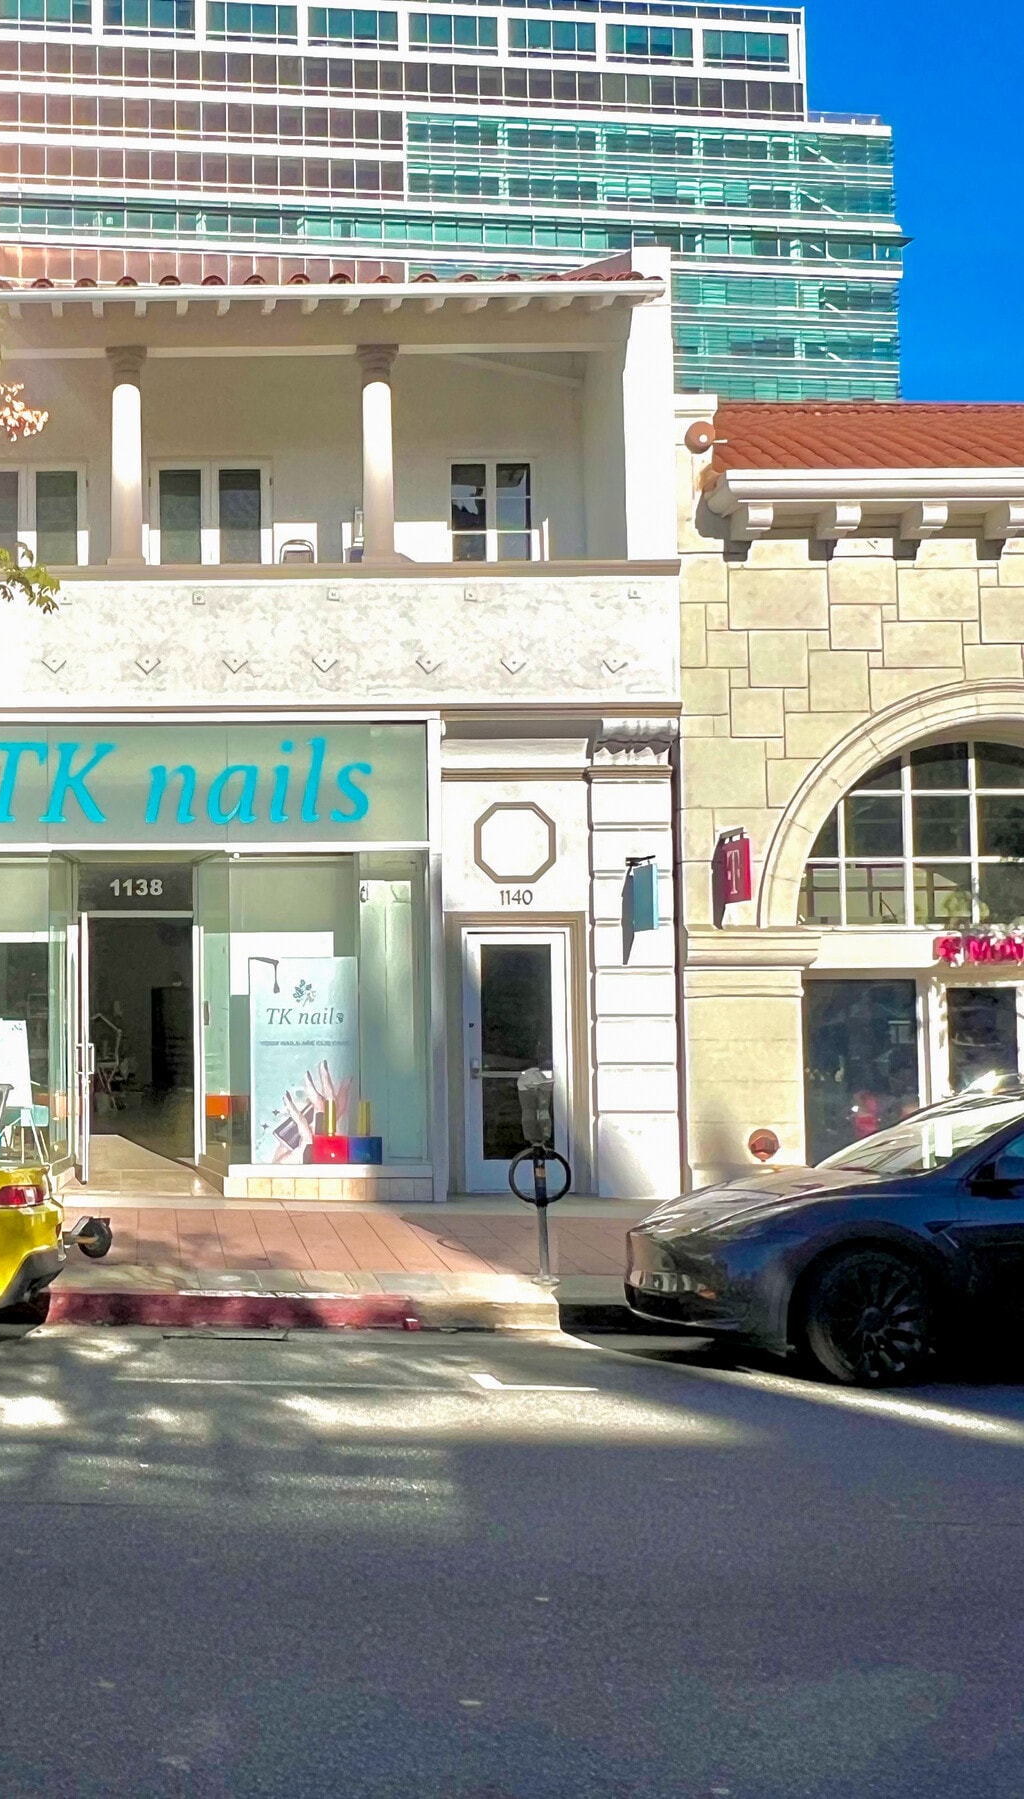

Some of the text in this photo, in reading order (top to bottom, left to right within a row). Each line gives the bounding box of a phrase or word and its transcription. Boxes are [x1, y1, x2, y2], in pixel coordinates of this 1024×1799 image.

[145, 736, 373, 825] nails
[726, 849, 741, 895] T
[109, 878, 163, 897] 1138
[499, 888, 534, 906] 1140
[266, 1007, 345, 1025] TK nails
